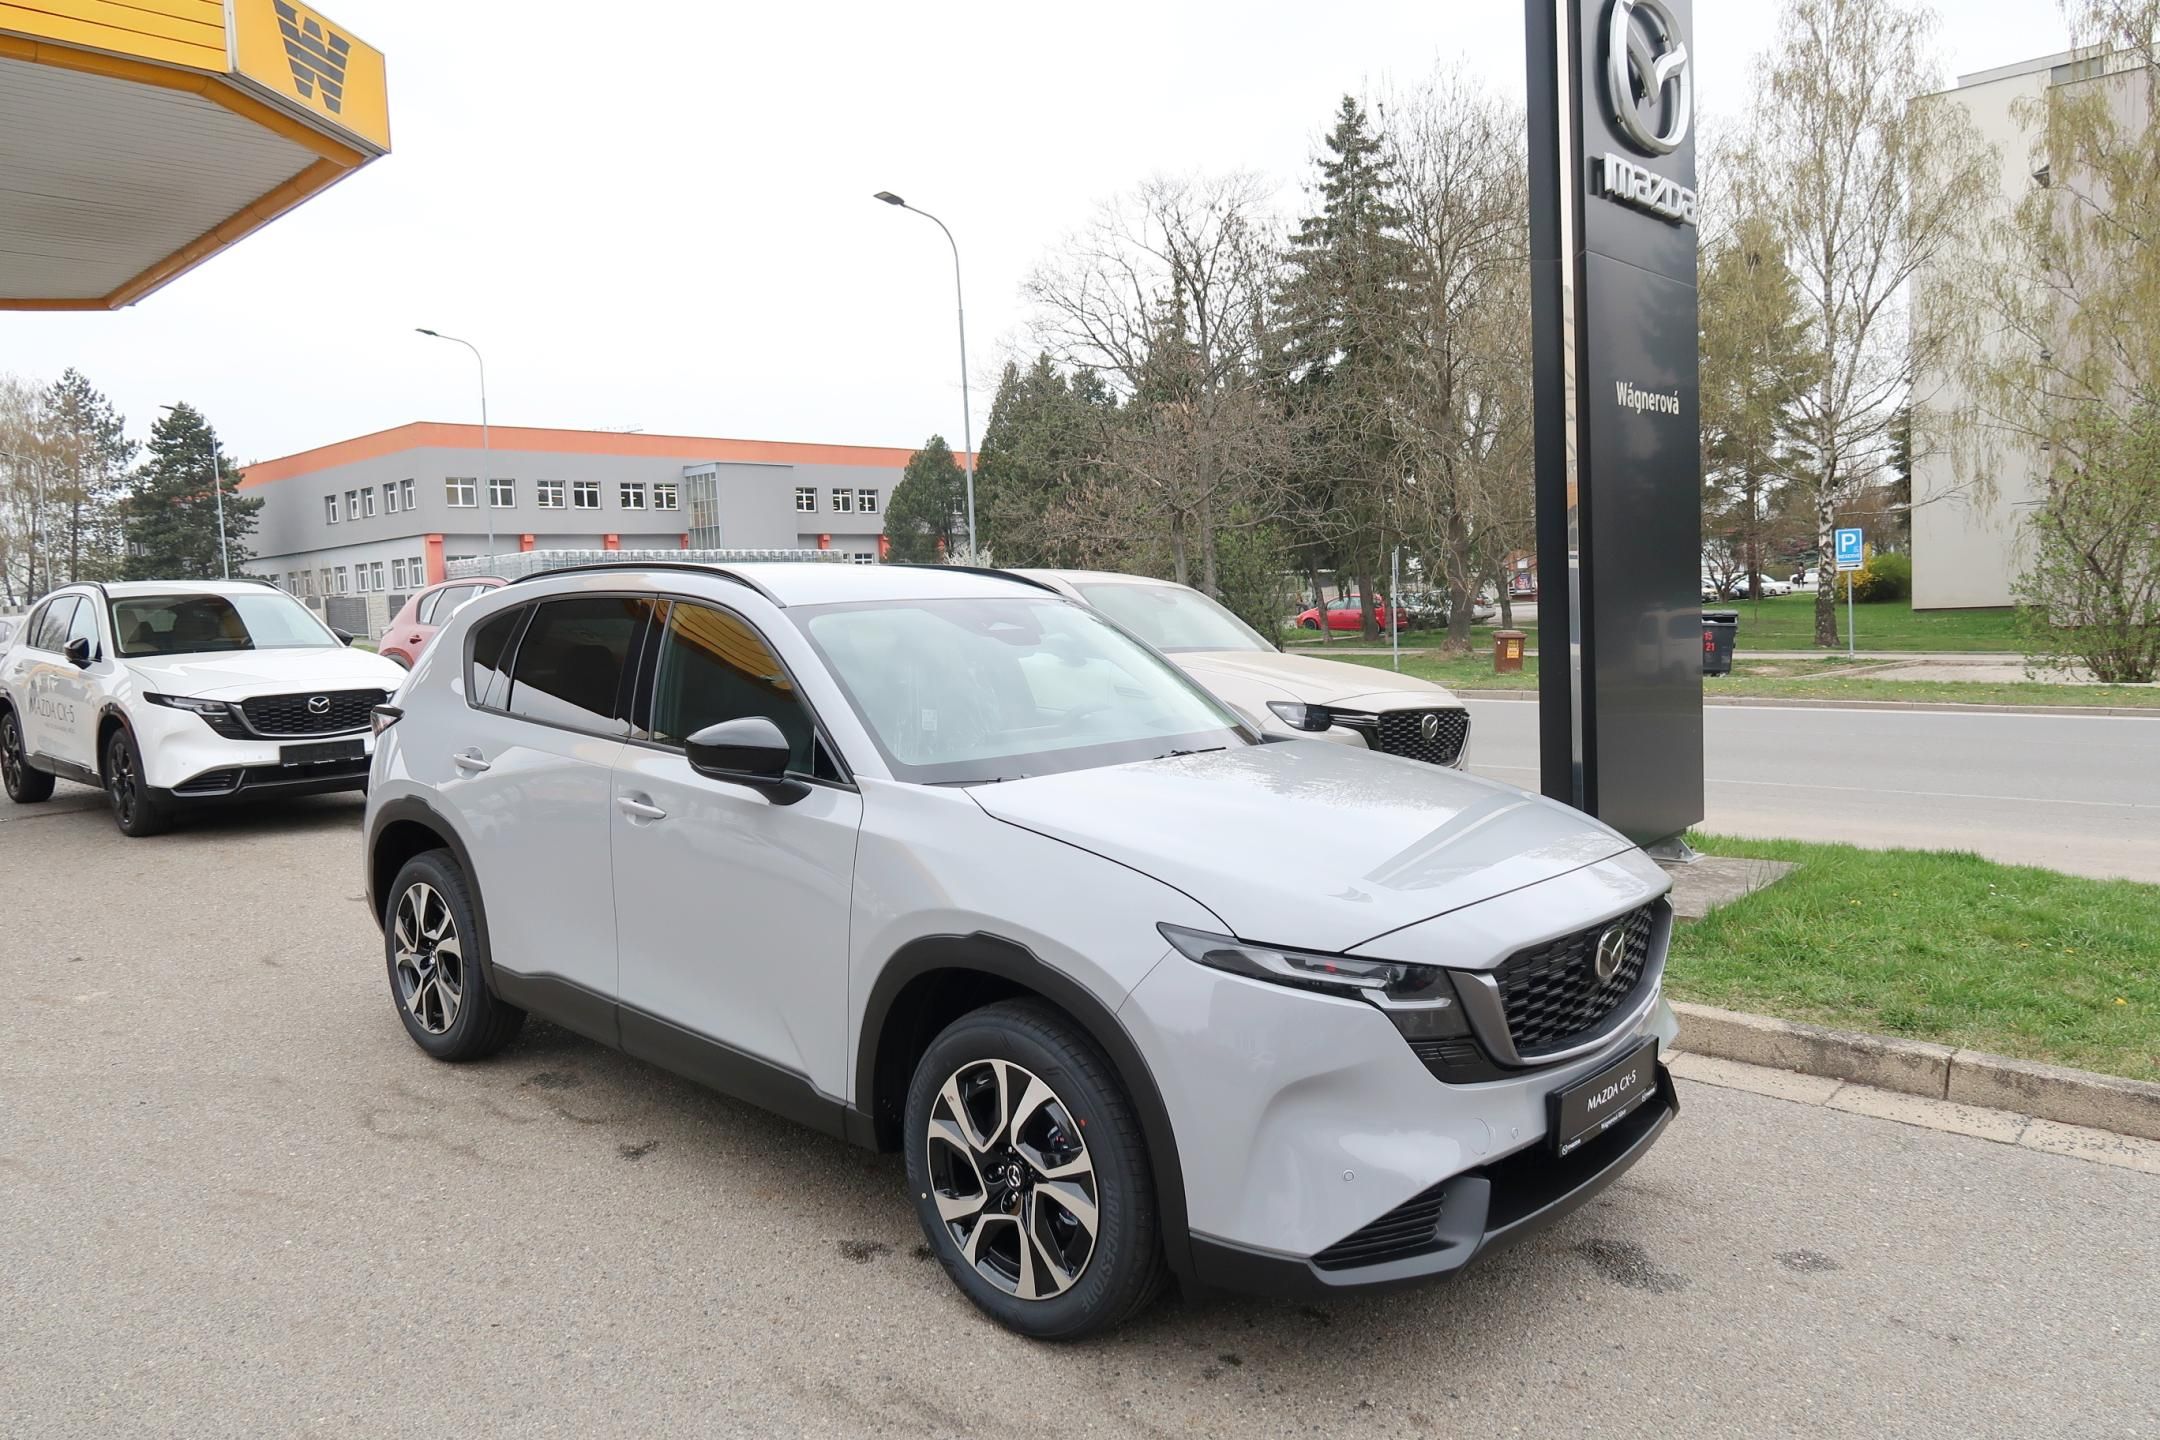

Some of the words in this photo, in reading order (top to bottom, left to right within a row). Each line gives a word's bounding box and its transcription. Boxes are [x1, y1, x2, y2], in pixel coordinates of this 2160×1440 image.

[1616, 381, 1679, 414] Wágnerová
[1842, 533, 1856, 552] P
[1588, 1083, 1618, 1112] MAZDA
[1620, 1069, 1636, 1090] CX-5
[1080, 1177, 1120, 1312] BRIDGESTONE
